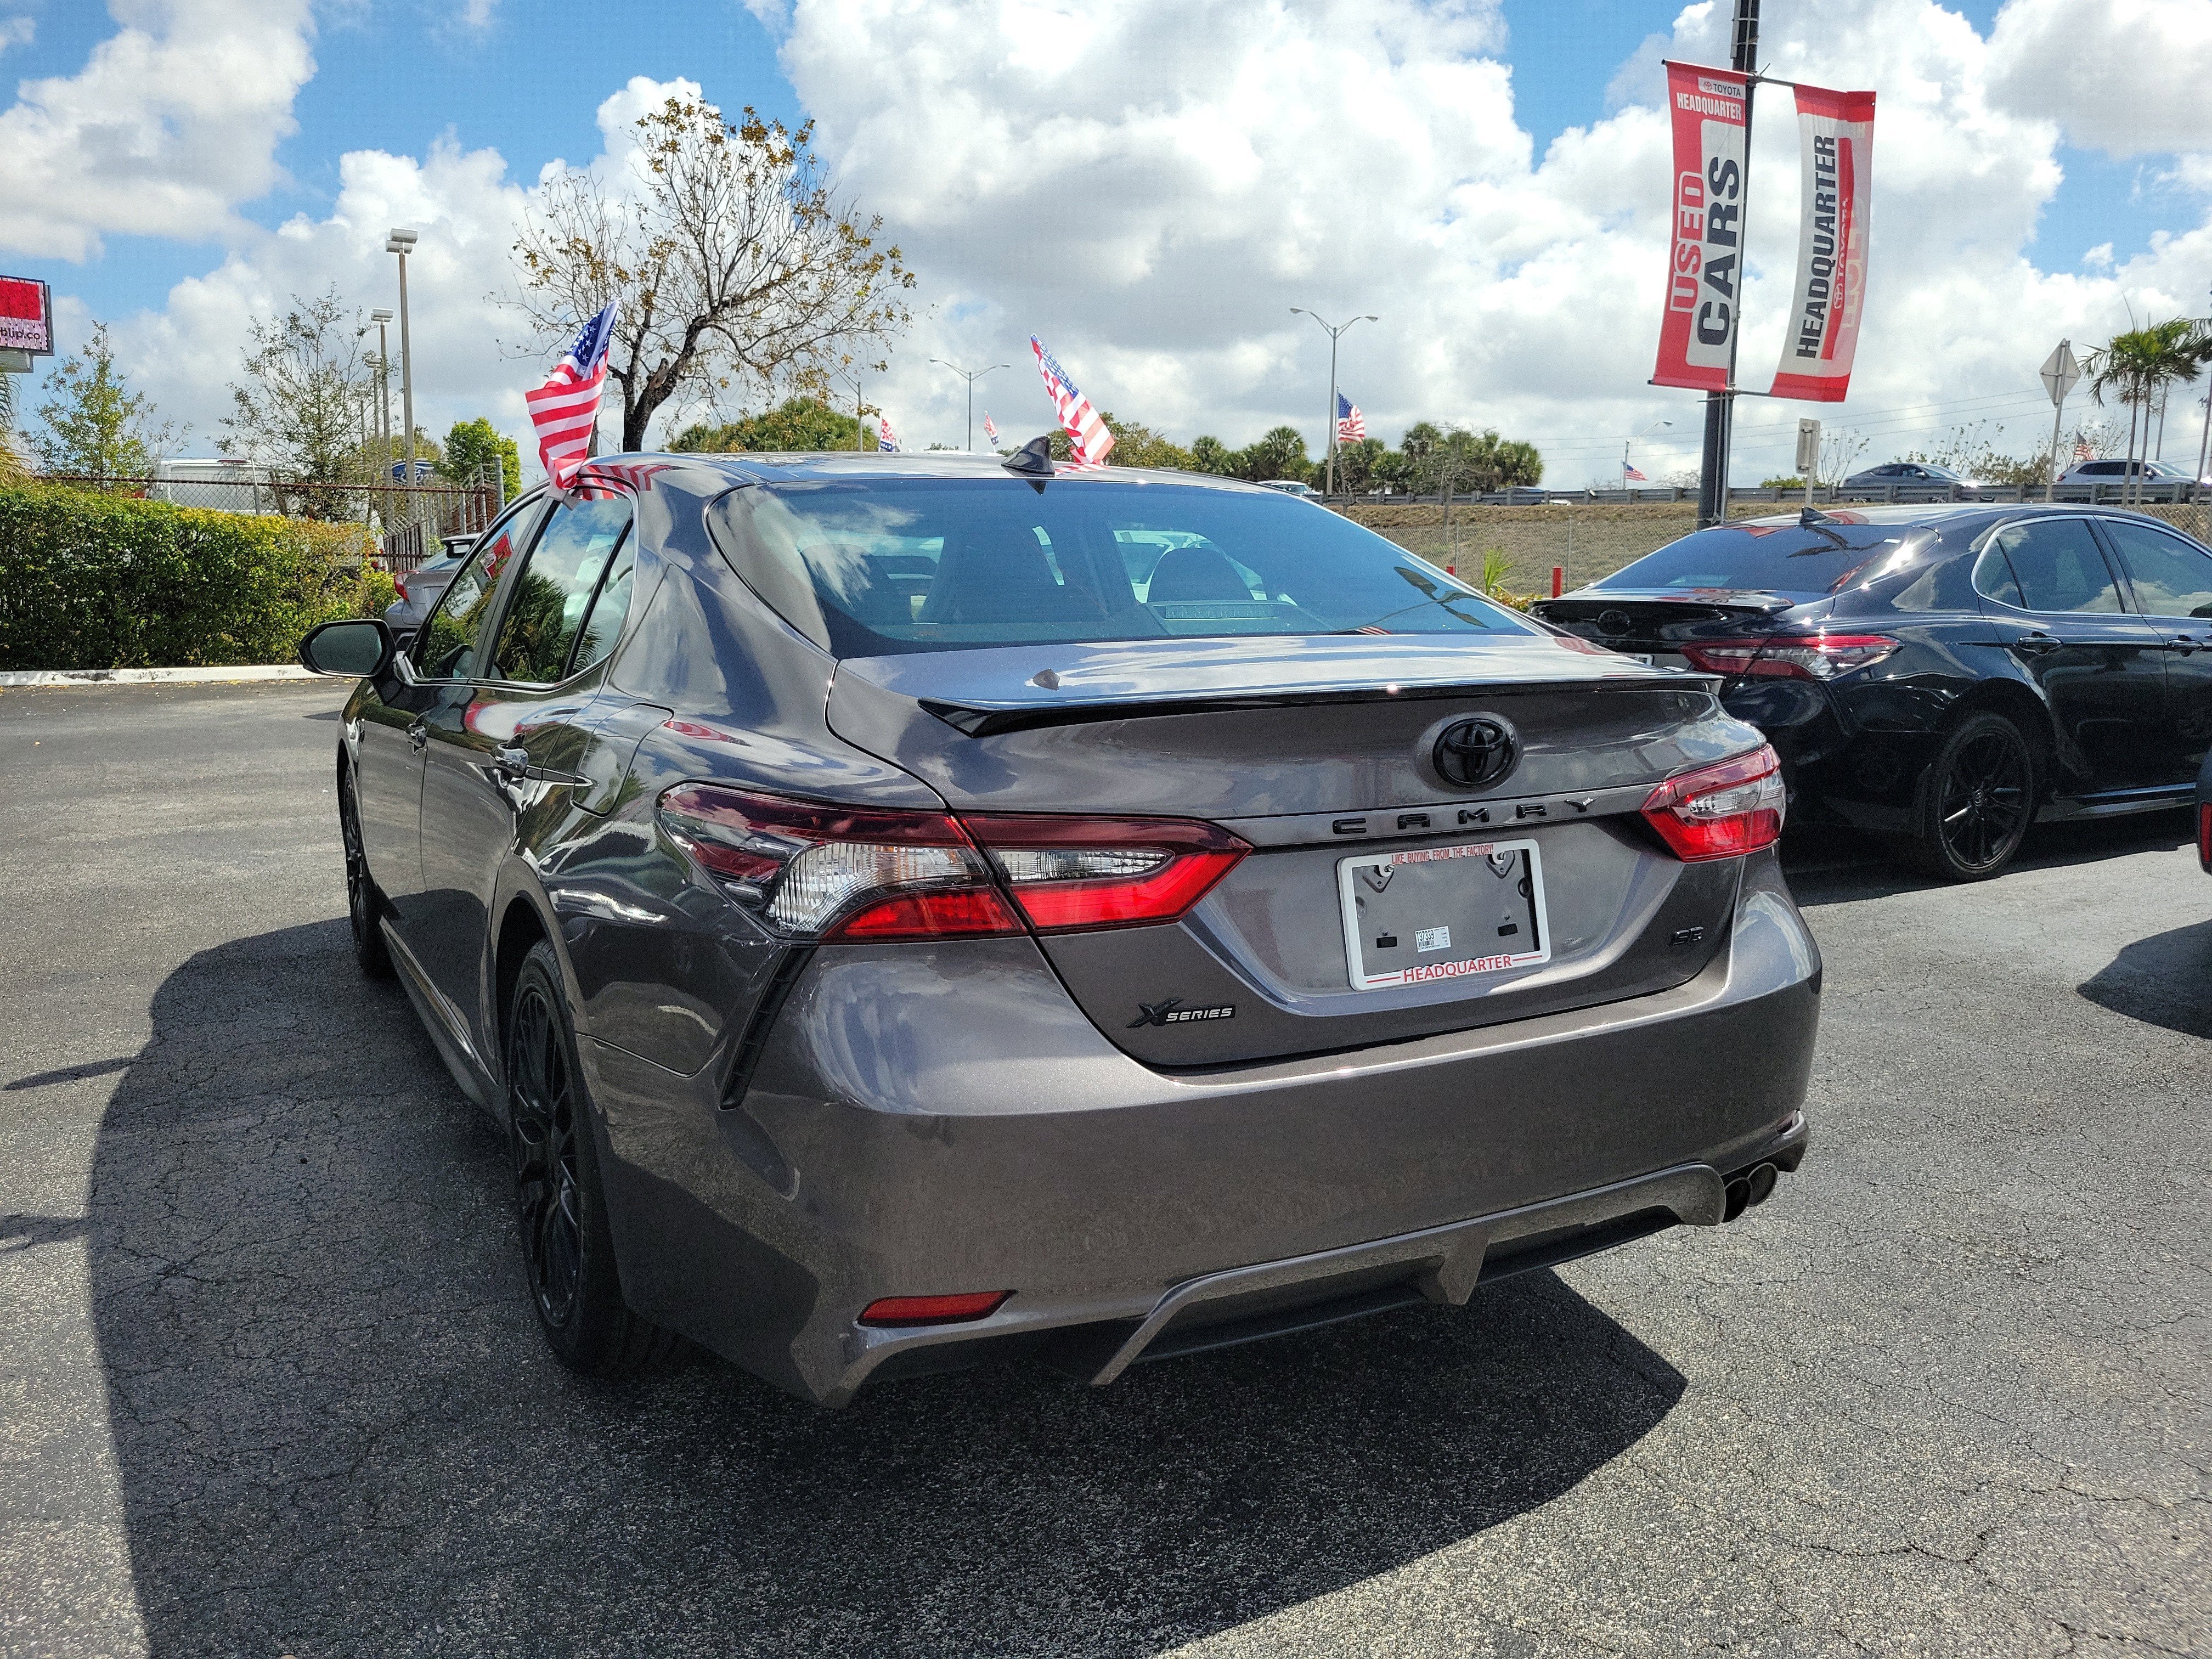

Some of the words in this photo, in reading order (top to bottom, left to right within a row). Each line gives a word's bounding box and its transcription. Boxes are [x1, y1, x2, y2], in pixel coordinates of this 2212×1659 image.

[1713, 83, 1741, 97] TOYOTA
[1677, 92, 1742, 121] HEADQUARTER
[1671, 171, 1705, 312] USED
[1697, 156, 1739, 346] CARS
[1795, 135, 1836, 358] HEADQUARTER
[1333, 795, 1599, 834] CAMRY
[1392, 854, 1405, 865] LIKE
[1407, 851, 1430, 863] BUYING
[1433, 848, 1450, 861] FROM
[1452, 847, 1464, 857] THE
[1466, 844, 1494, 857] FACTORY!
[1673, 926, 1704, 945] SE
[1403, 955, 1513, 982] HEADQUARTER
[1166, 1007, 1233, 1022] SERIES
